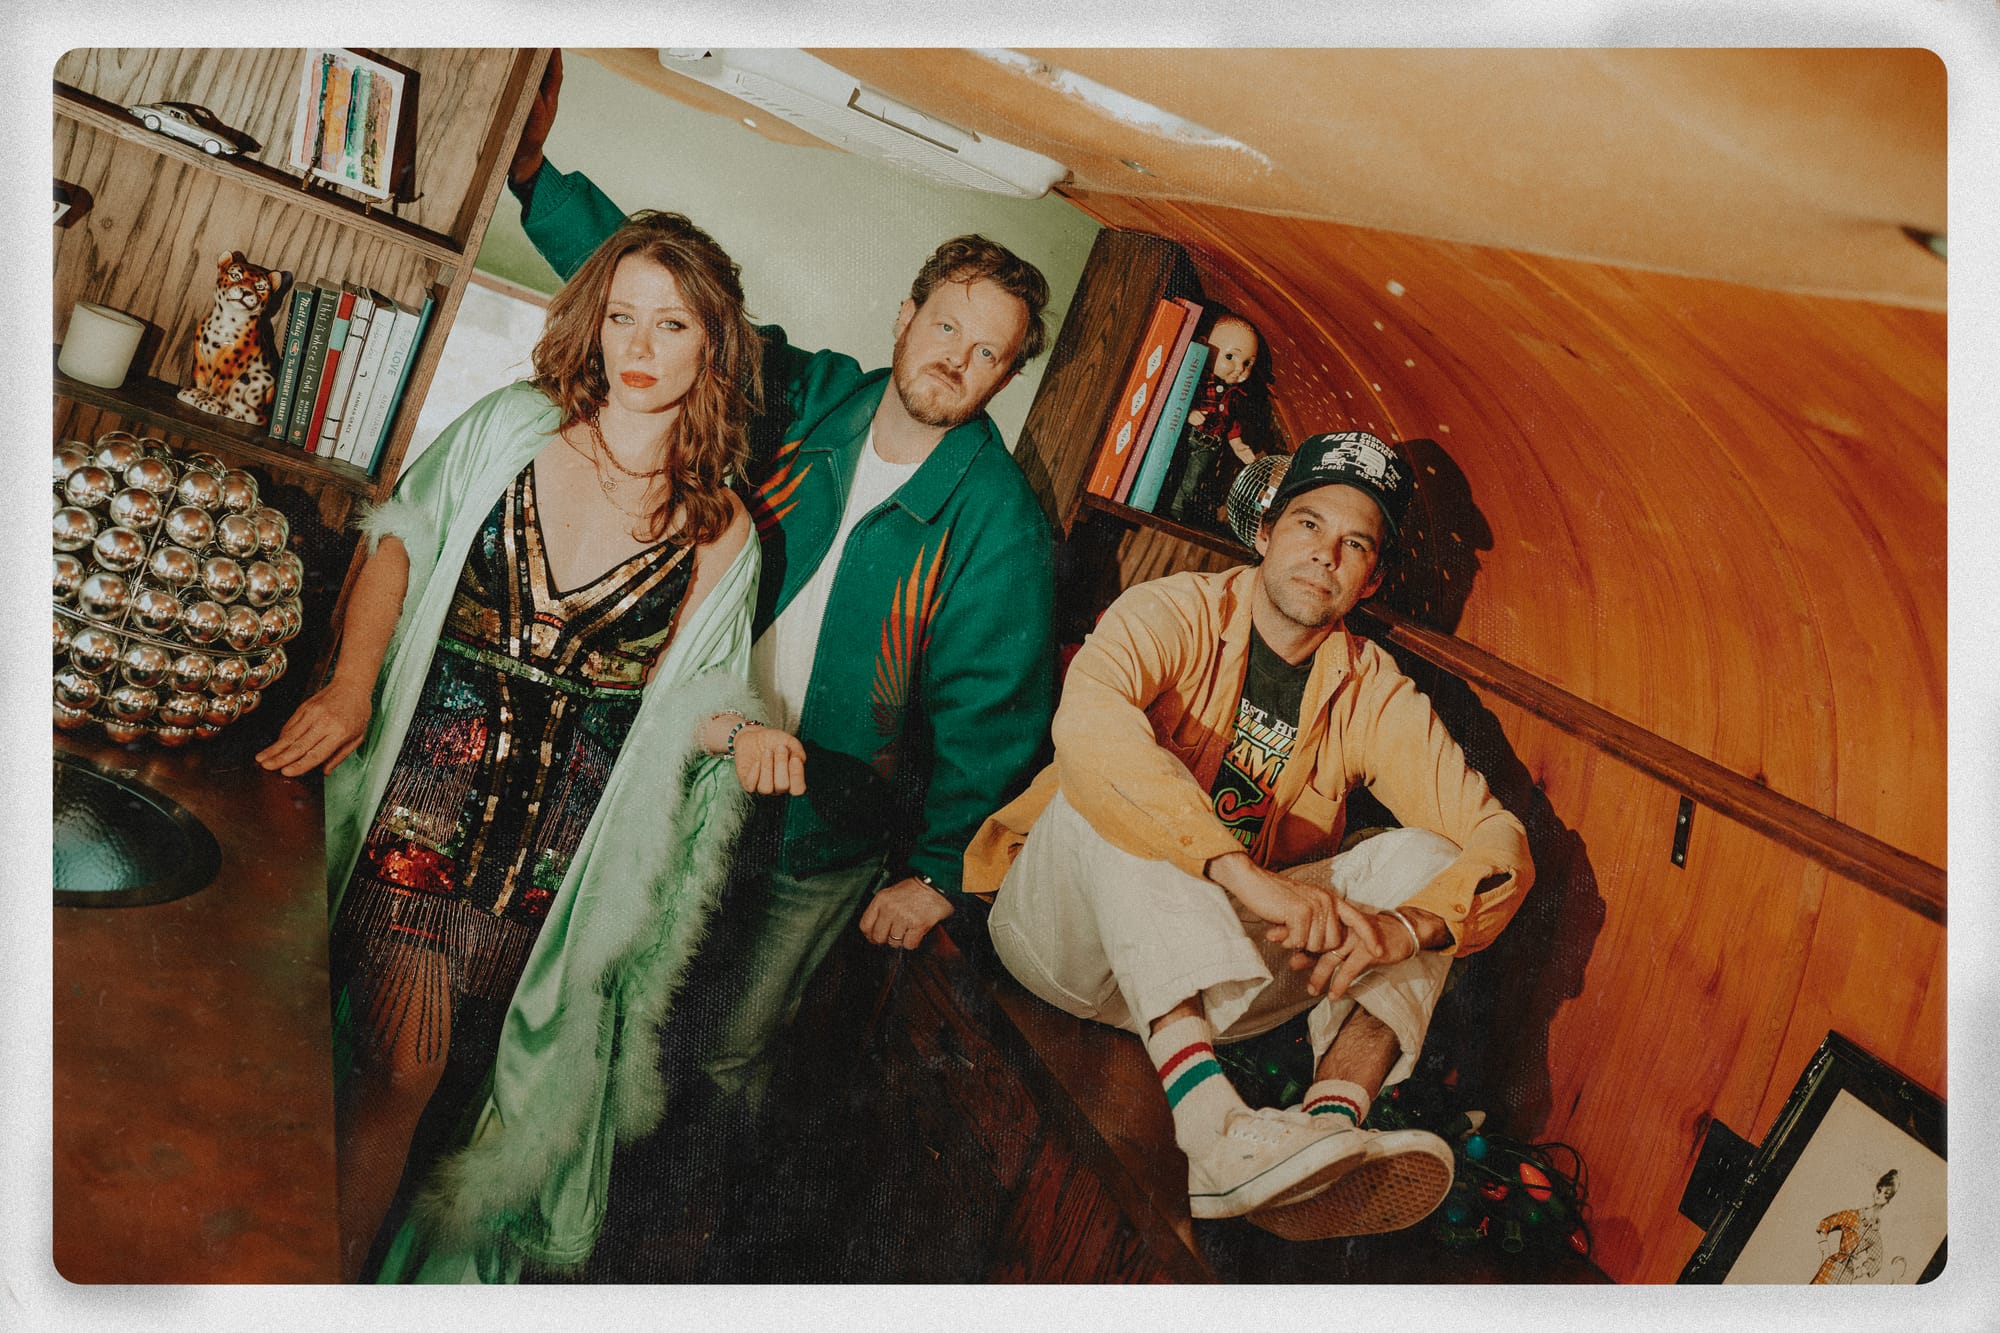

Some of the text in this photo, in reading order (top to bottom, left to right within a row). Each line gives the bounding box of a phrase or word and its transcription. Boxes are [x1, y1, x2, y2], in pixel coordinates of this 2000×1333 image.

[297, 297, 311, 318] Matt
[319, 303, 333, 321] this
[291, 319, 306, 337] Haig
[316, 324, 327, 332] is
[309, 334, 323, 361] where
[388, 350, 404, 376] LOVE
[282, 368, 293, 396] MIDNIGHT
[302, 375, 313, 394] ends
[1179, 357, 1200, 402] SHABBY
[277, 397, 288, 420] LIBRARY
[1320, 432, 1358, 443] PDQ
[1359, 438, 1393, 460] SERVICE
[1241, 697, 1268, 724] EST
